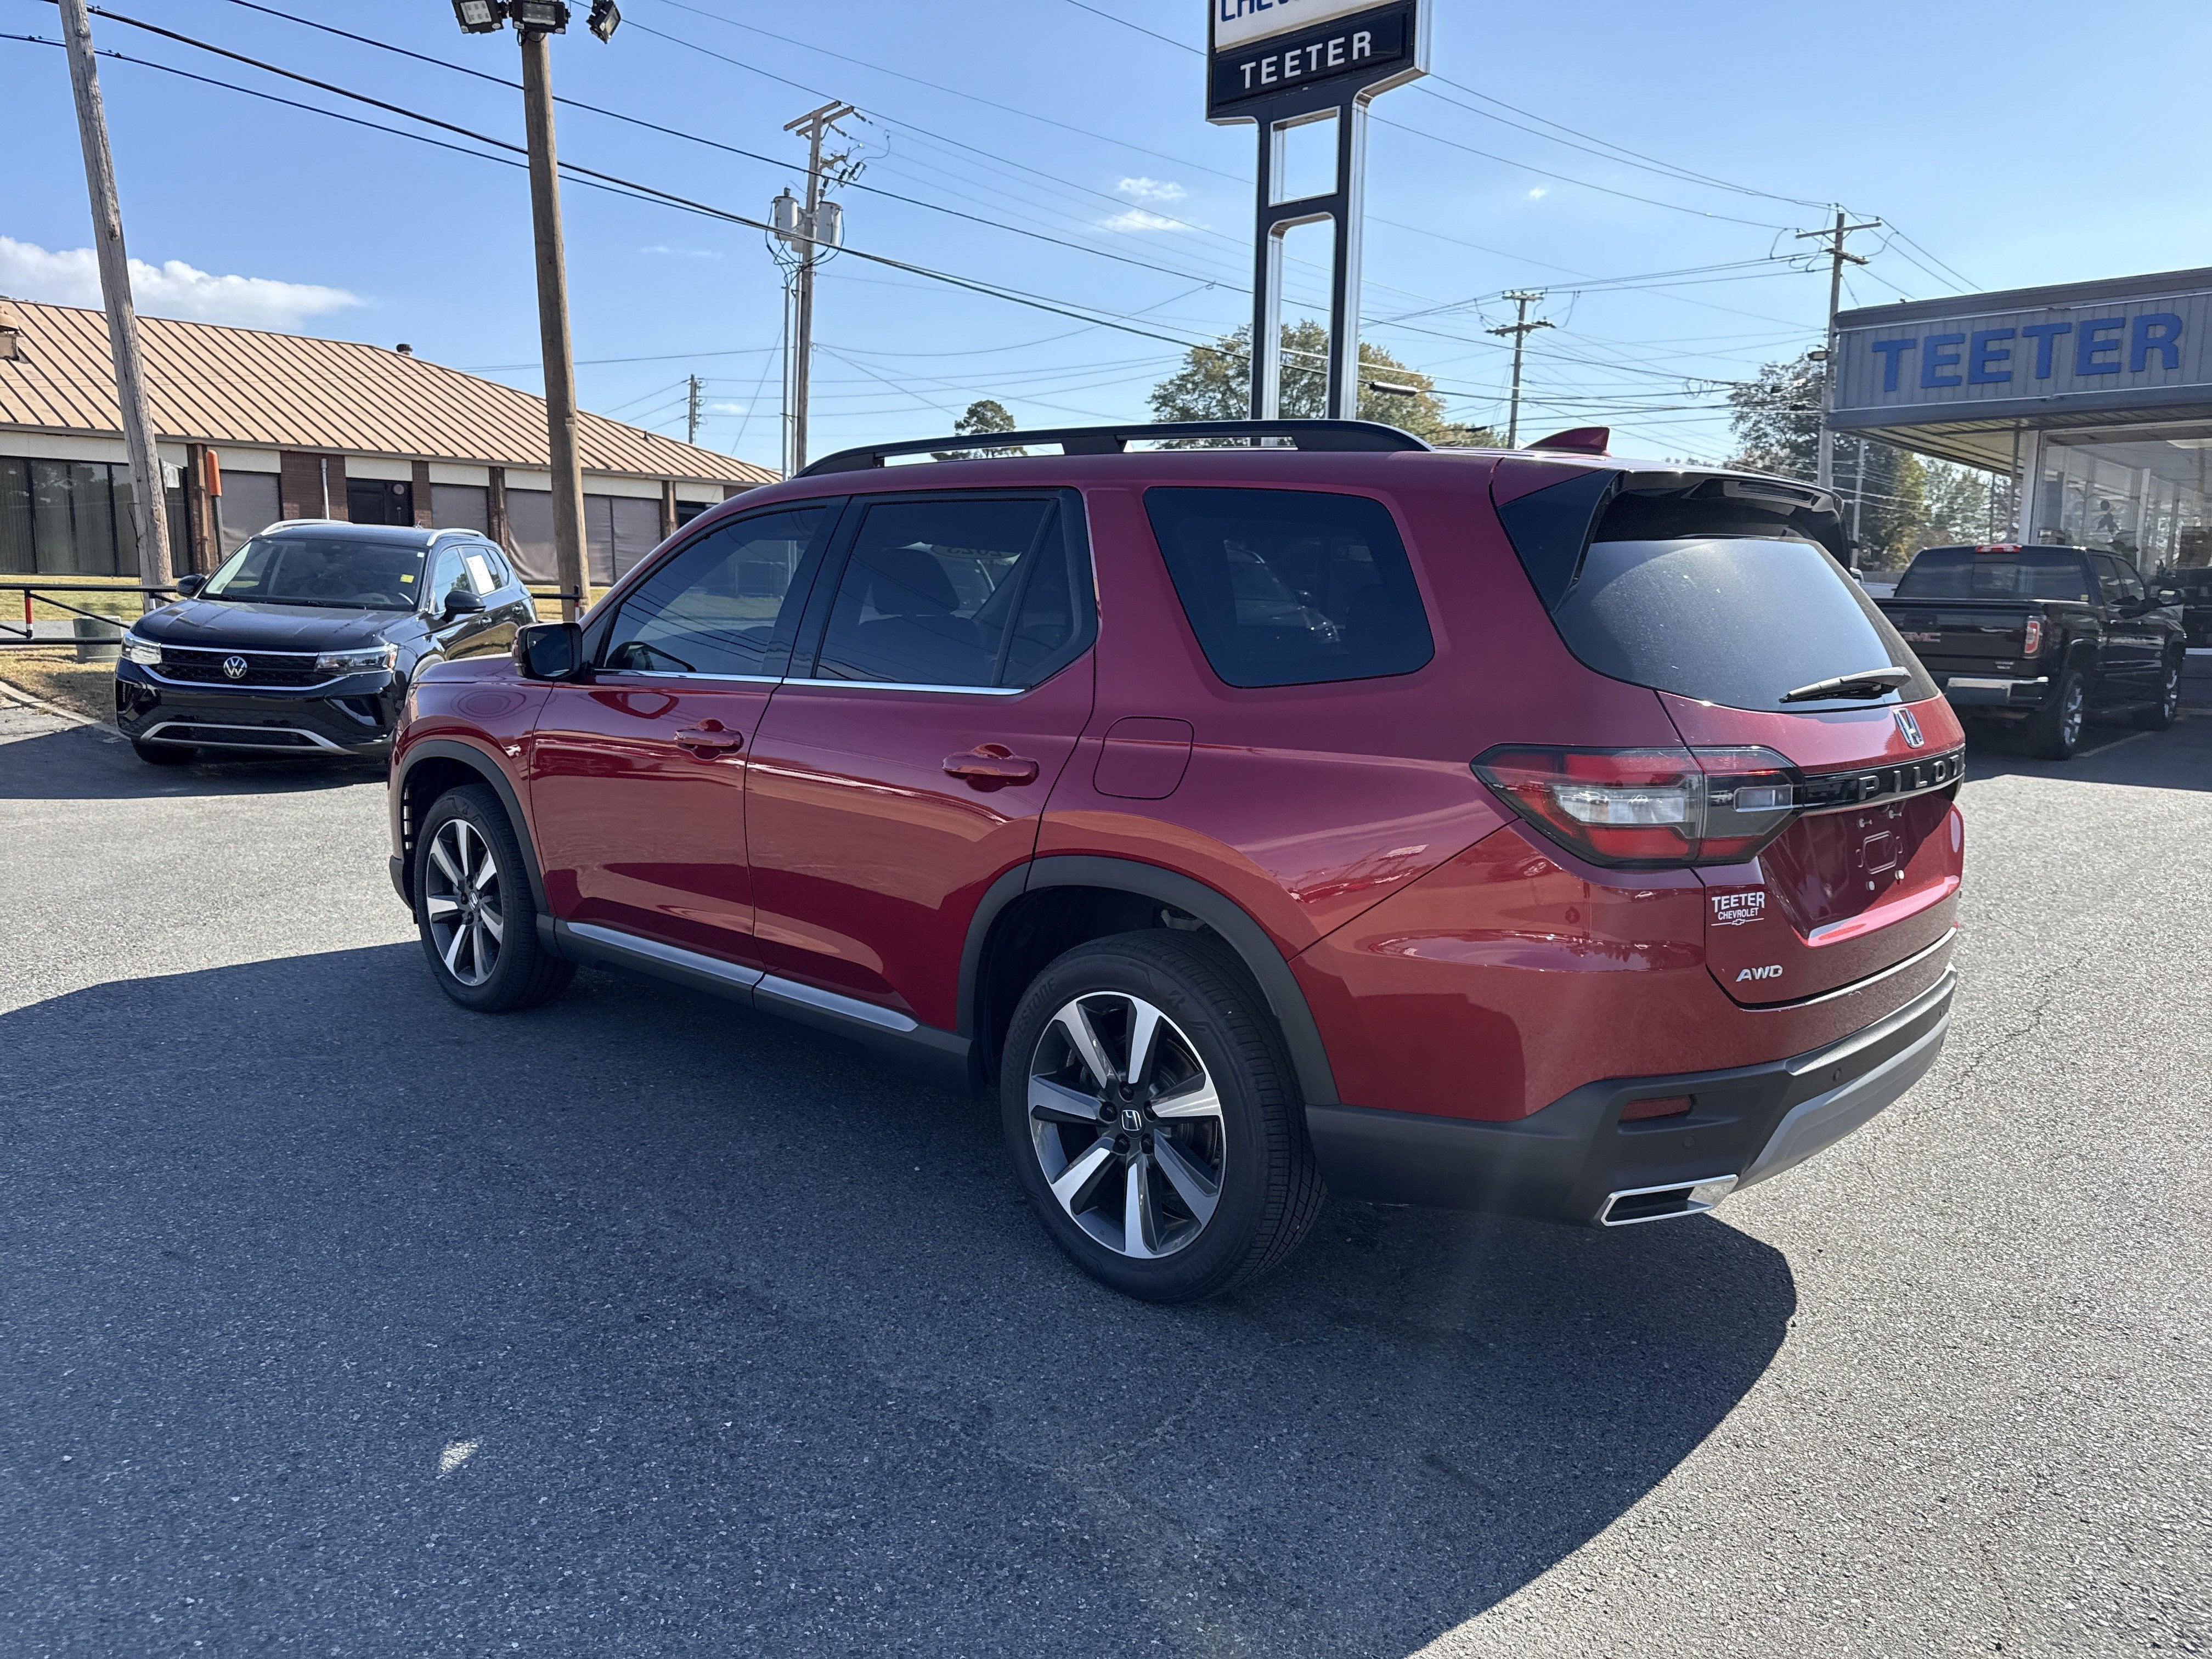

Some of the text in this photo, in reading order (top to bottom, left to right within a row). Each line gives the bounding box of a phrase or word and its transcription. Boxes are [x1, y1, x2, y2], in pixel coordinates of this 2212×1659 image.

[1240, 31, 1372, 89] TEETER
[1871, 313, 2183, 392] TEETER
[1858, 754, 1959, 800] PILOT
[1711, 891, 1765, 913] TEETER
[1718, 907, 1759, 921] CHEVROLET
[1736, 964, 1783, 982] AWD
